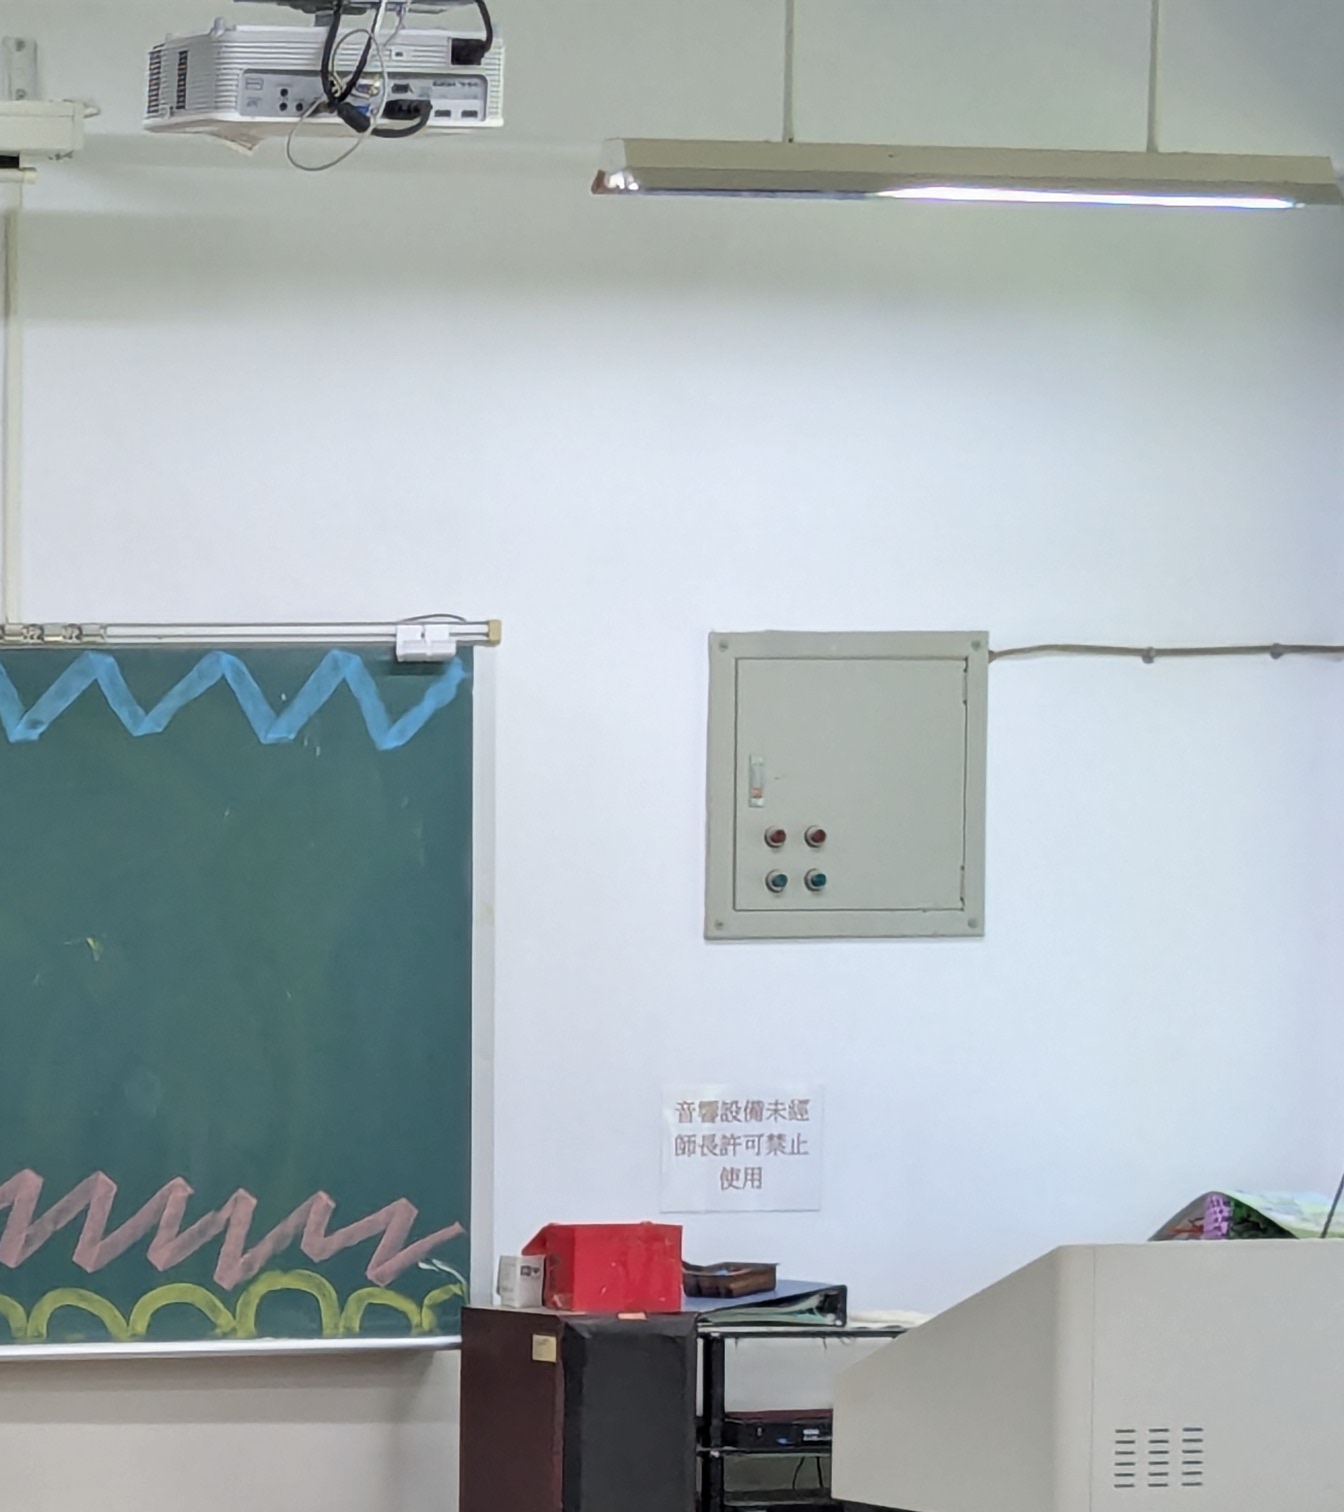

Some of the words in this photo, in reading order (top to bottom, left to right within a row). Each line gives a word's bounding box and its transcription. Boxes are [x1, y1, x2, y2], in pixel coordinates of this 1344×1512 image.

[675, 1099, 811, 1124] 音響設備未經
[674, 1132, 810, 1157] 師長許可禁止
[720, 1166, 763, 1191] 使用
